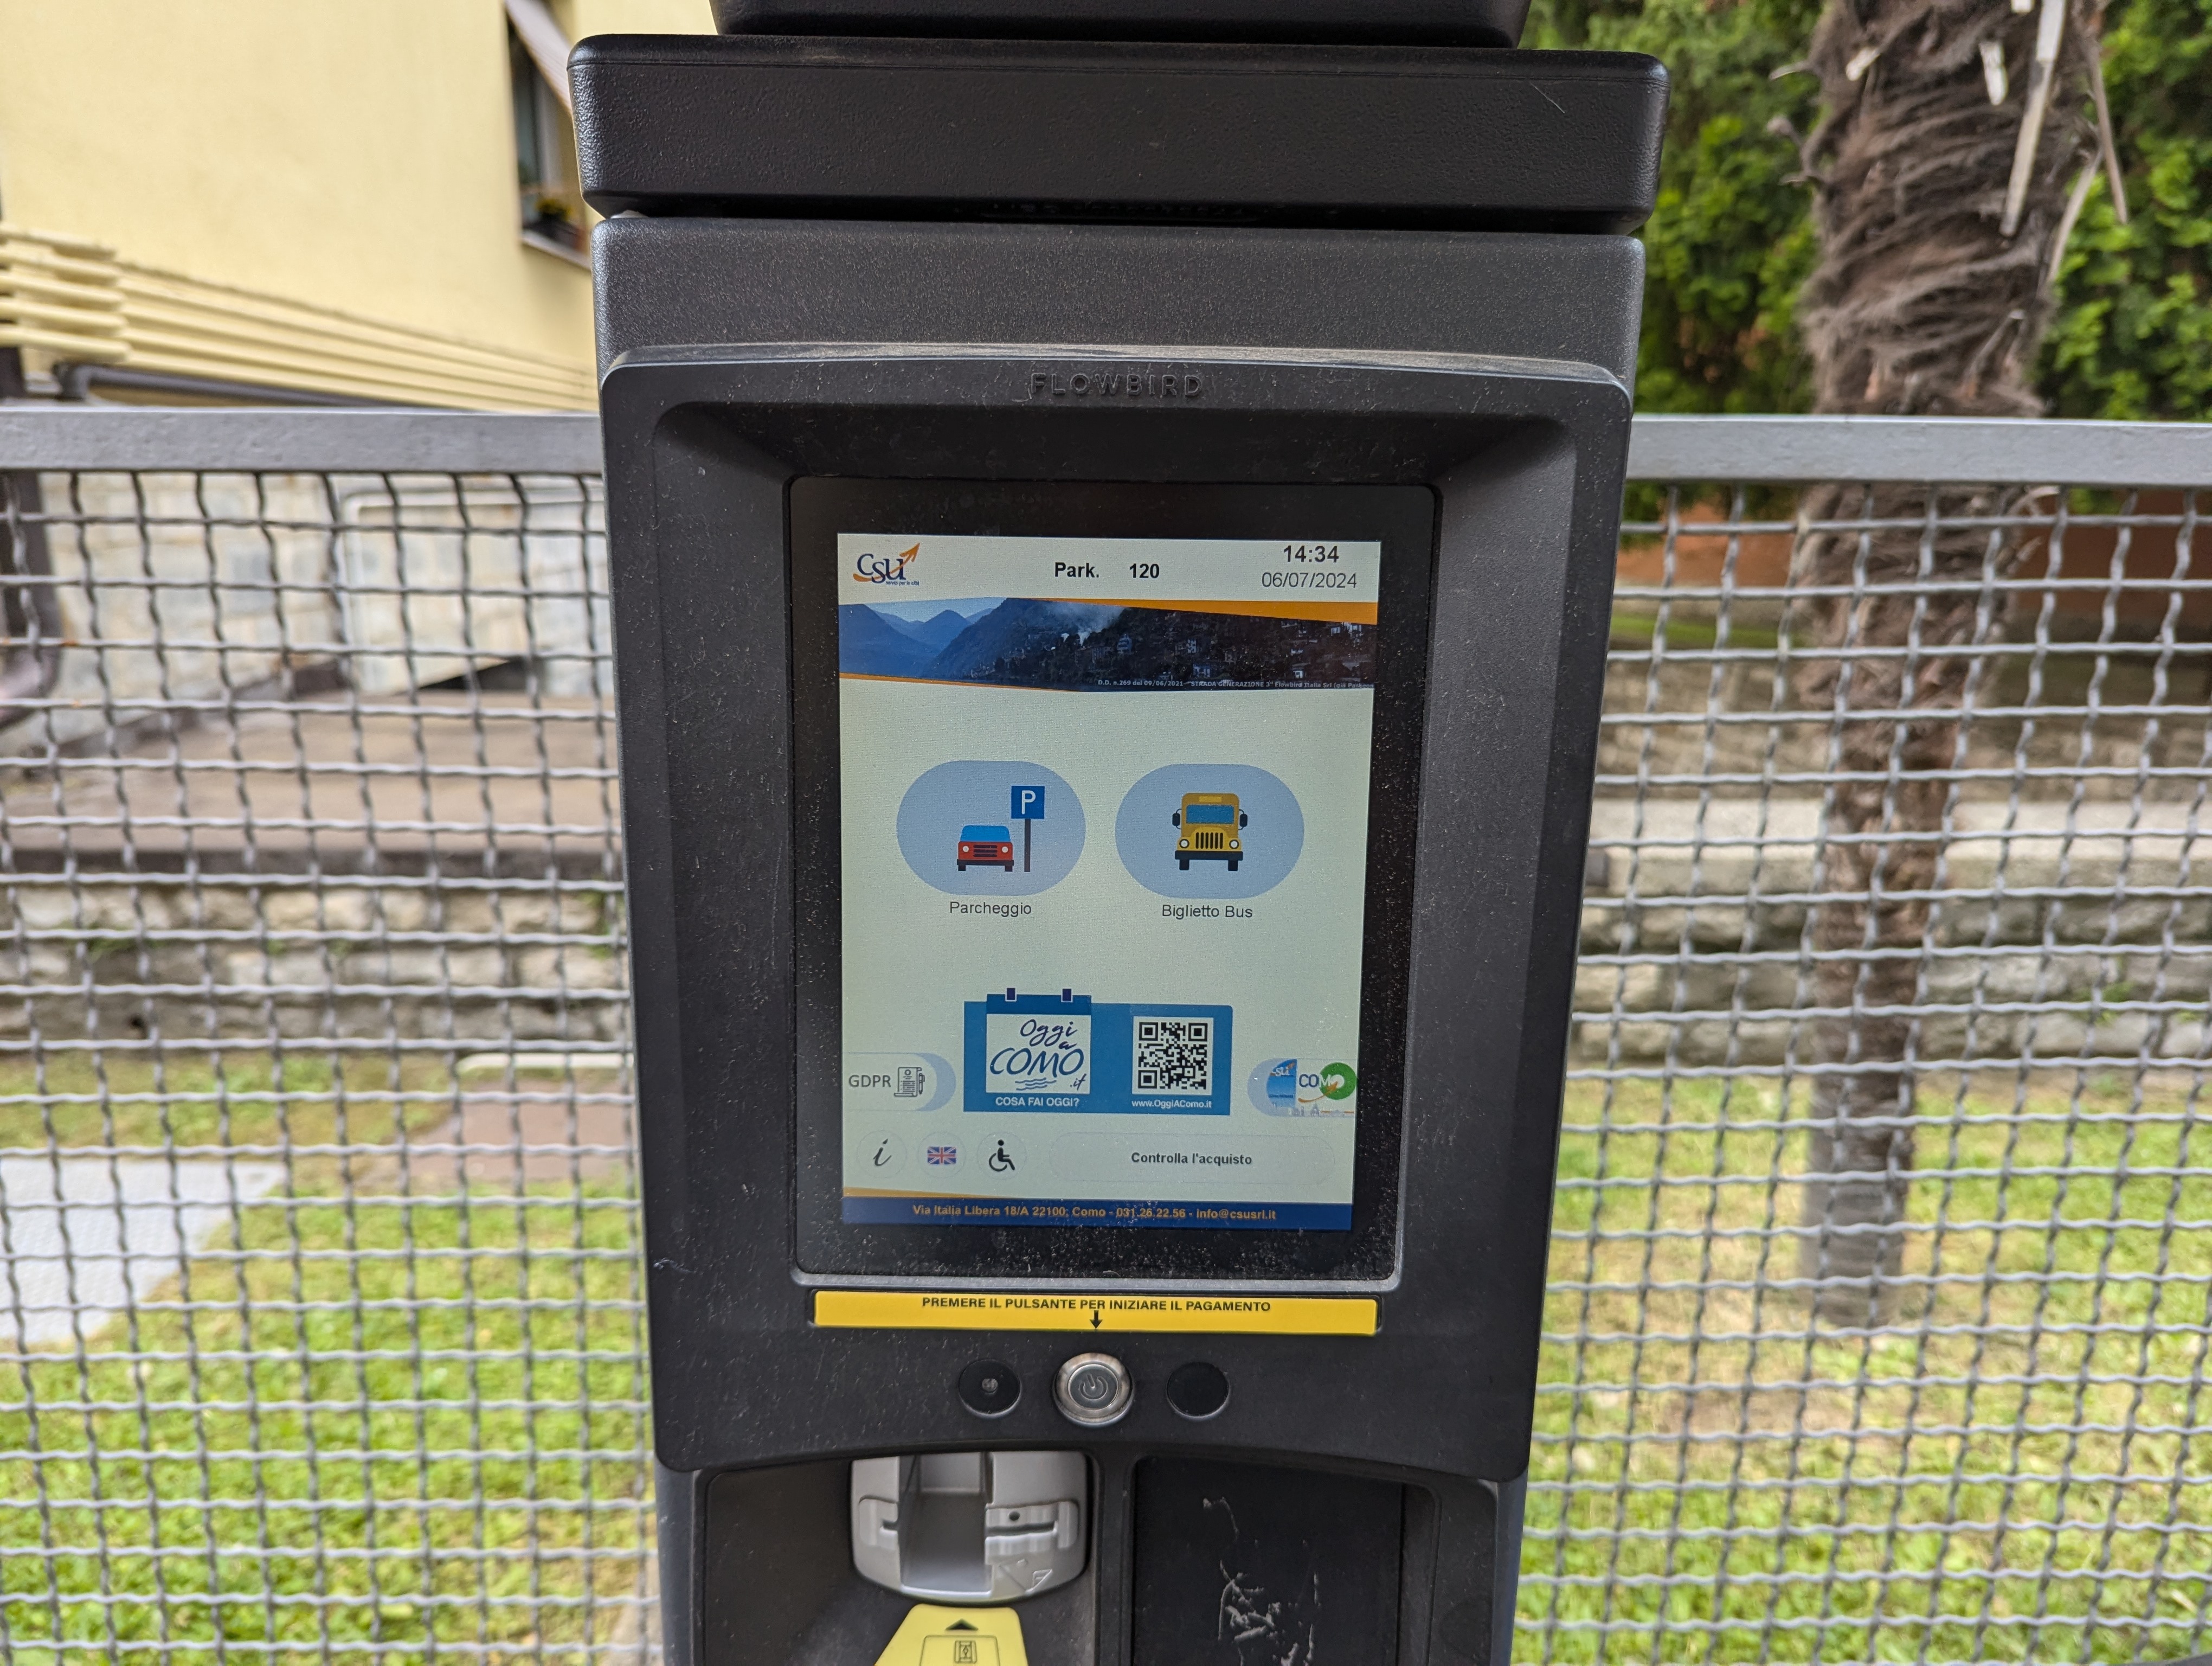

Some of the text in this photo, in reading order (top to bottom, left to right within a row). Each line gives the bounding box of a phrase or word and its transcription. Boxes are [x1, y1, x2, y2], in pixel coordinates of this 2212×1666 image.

[1031, 373, 1202, 396] FLOWBIRD
[1283, 544, 1339, 563] 14:34
[1054, 562, 1160, 579] Park. 120
[1262, 572, 1357, 588] 06/07/2024
[1021, 790, 1036, 815] P
[950, 901, 1032, 918] Parcheggio
[1162, 904, 1253, 920] Biglietto Bus
[1020, 1019, 1077, 1047] Oggi
[989, 1047, 1084, 1078] COMO
[848, 1074, 891, 1088] GDPR
[995, 1097, 1080, 1107] COSA FAI OGGI?
[1131, 1099, 1212, 1109] www.OggiAComo.it
[1131, 1152, 1252, 1166] Controlla l'acquisto
[912, 1204, 931, 1215] Via
[934, 1205, 961, 1215] Italia
[964, 1205, 1000, 1215] Libera
[1004, 1205, 1029, 1216] 18/A
[1072, 1207, 1107, 1217] Como
[1116, 1207, 1186, 1218] 031.26.22.56
[1197, 1208, 1276, 1219] info@csusrl.it
[922, 1297, 1271, 1311] PREMERE IL PULSANTE PER INIZIARE IL PAGAMENTO
